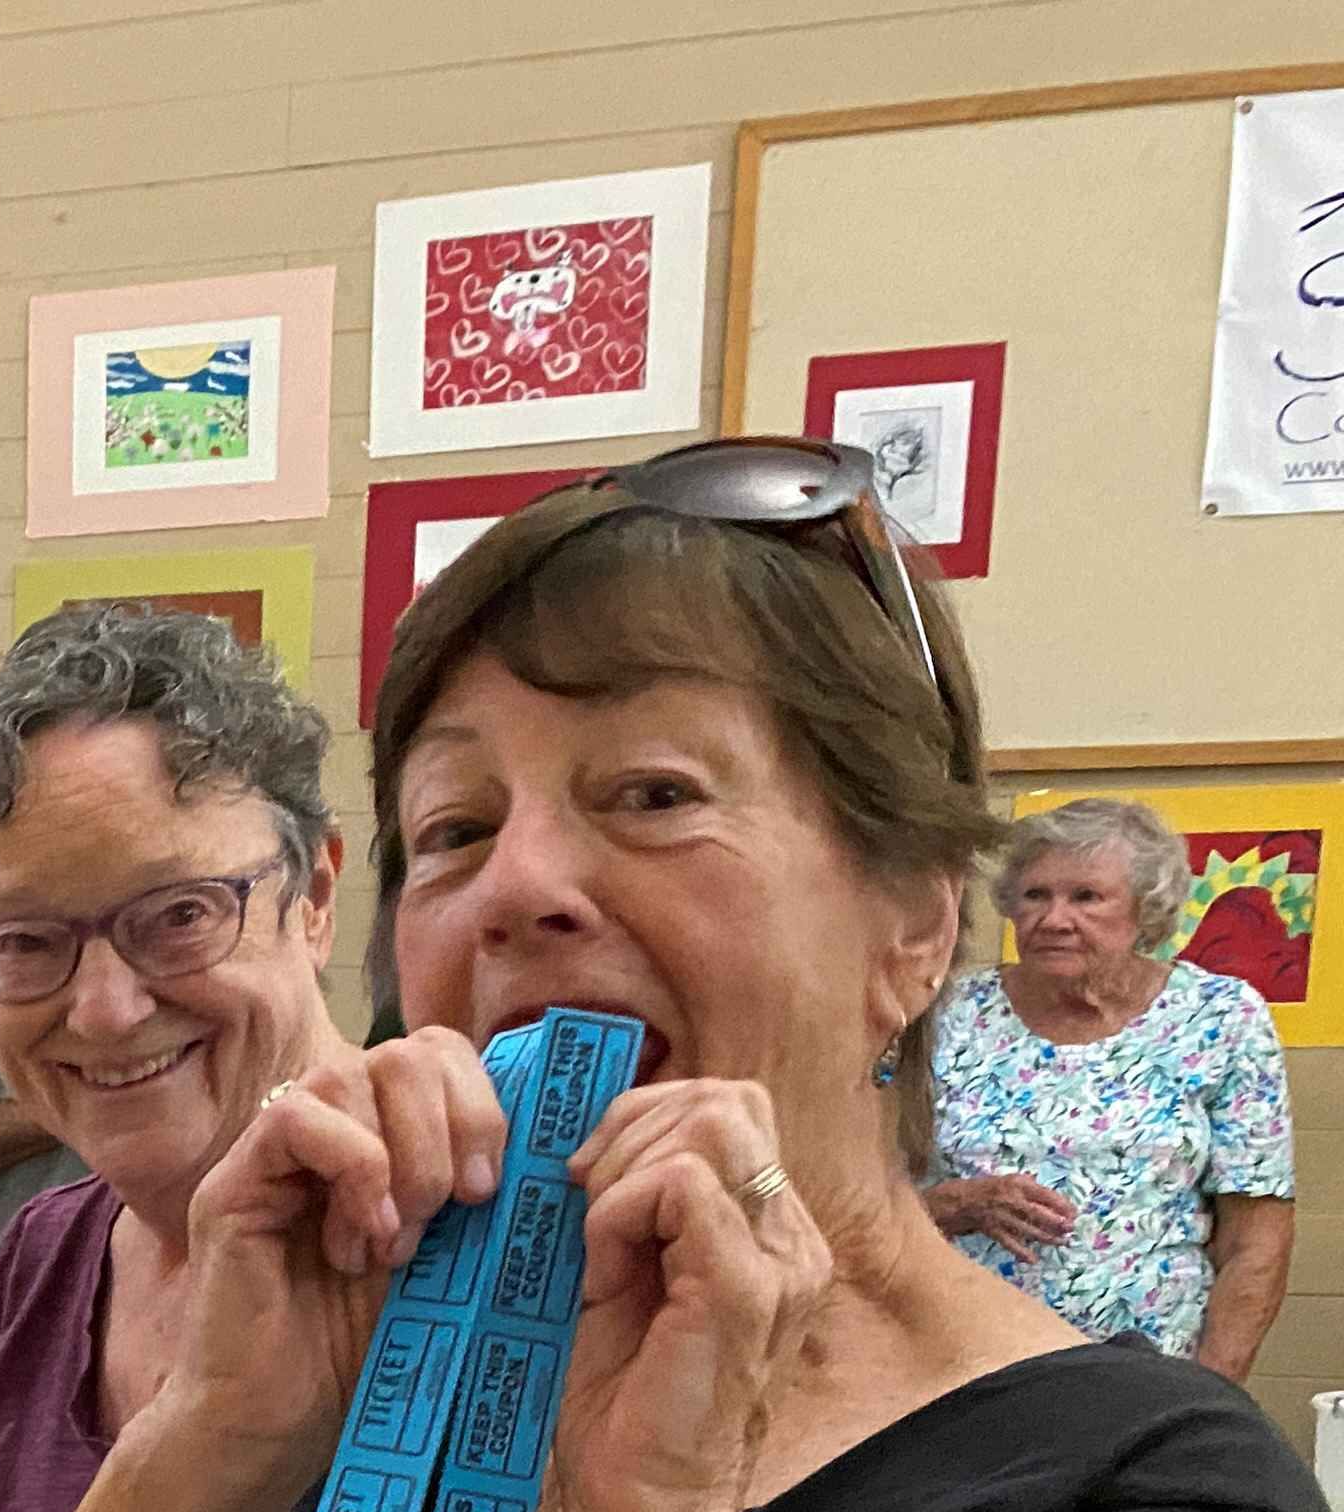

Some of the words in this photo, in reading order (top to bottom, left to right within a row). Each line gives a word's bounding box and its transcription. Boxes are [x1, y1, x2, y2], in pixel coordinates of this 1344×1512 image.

[534, 1089, 562, 1150] KEEP
[553, 1026, 578, 1078] THIS
[558, 1040, 593, 1142] COUPON
[500, 1250, 528, 1309] KEEP
[516, 1185, 542, 1241] THIS
[522, 1200, 560, 1300] COUPON
[364, 1338, 413, 1428] TICKET
[466, 1401, 491, 1463] KEEP
[482, 1343, 507, 1391] THIS
[488, 1359, 524, 1456] COUPON
